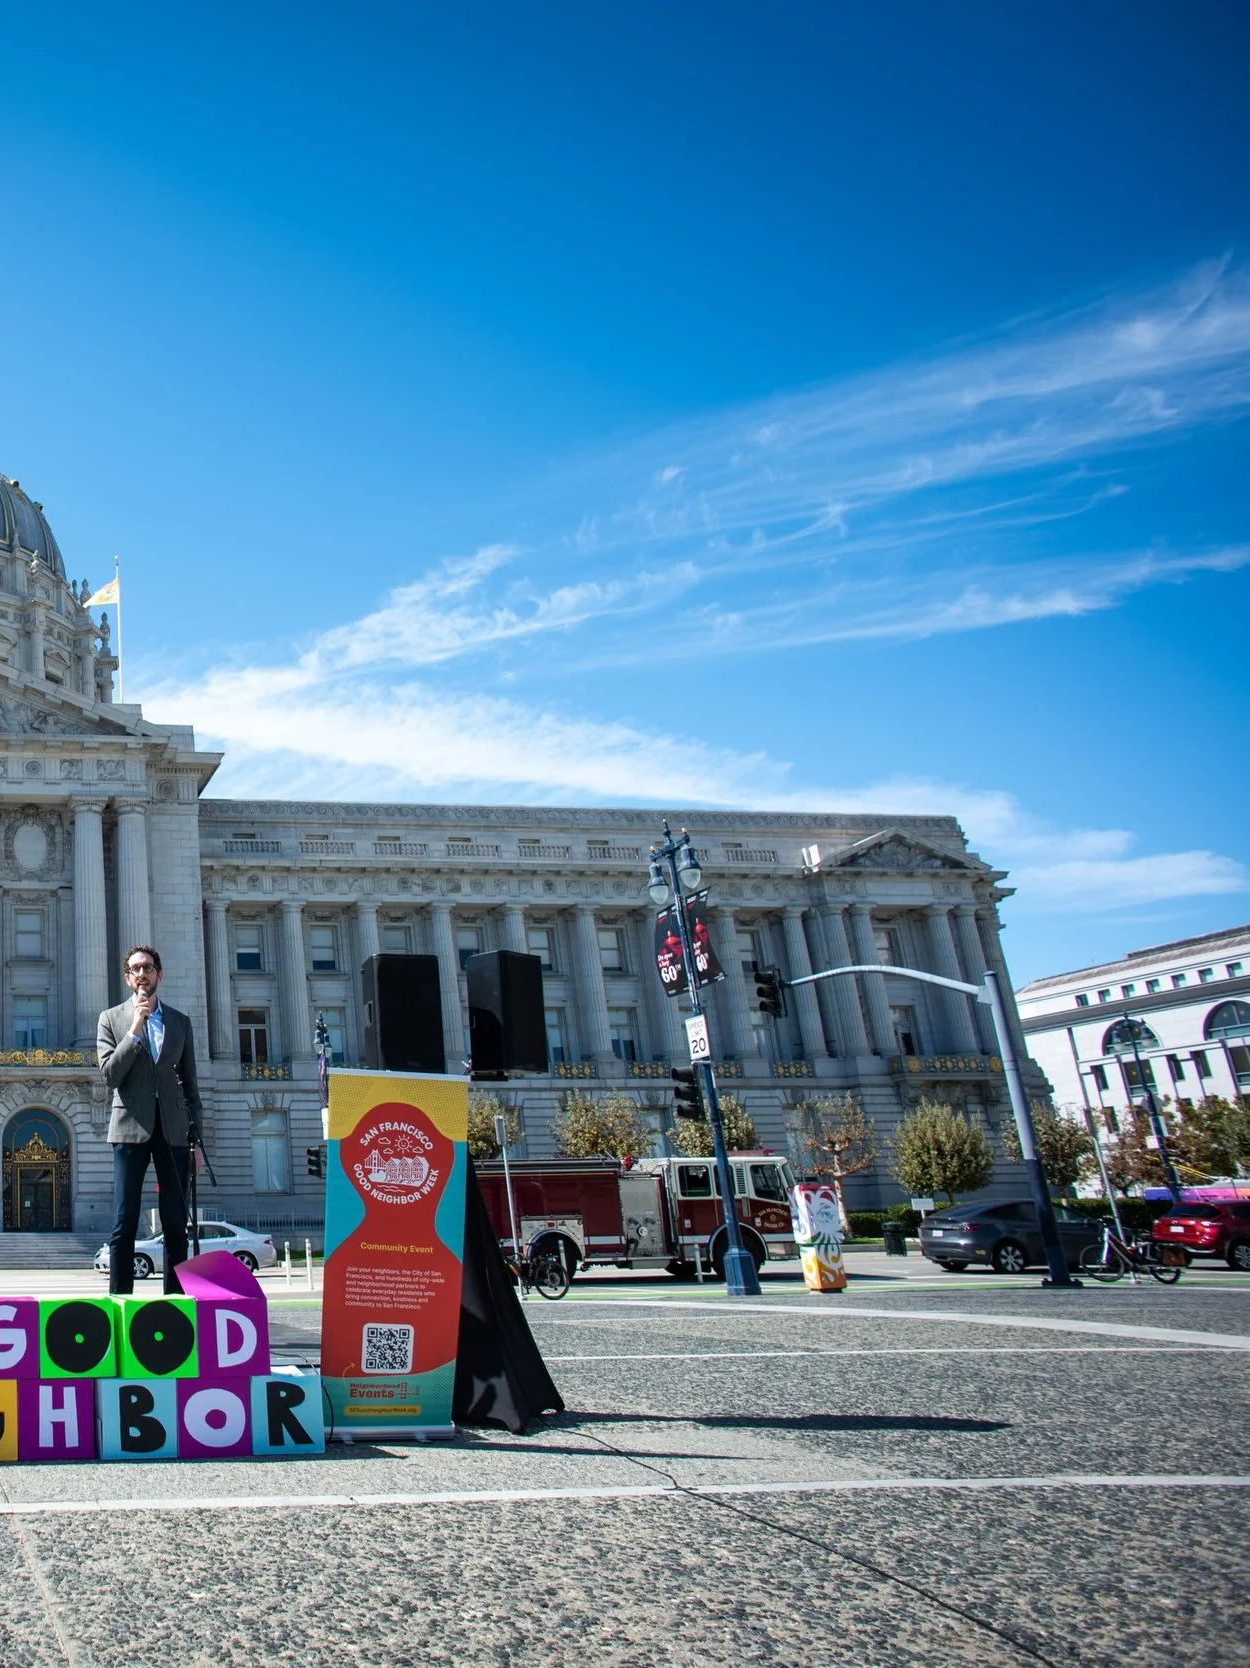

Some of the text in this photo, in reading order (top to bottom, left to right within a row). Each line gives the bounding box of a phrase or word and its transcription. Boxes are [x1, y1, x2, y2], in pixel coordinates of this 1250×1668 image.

[688, 1020, 704, 1031] SPEED
[692, 1038, 706, 1054] 20
[360, 1122, 433, 1150] SAN FRANCISCO
[354, 1163, 439, 1204] GOOD NEIGHBOR WEEK
[360, 1242, 433, 1254] Community Event
[350, 1389, 394, 1398] Events
